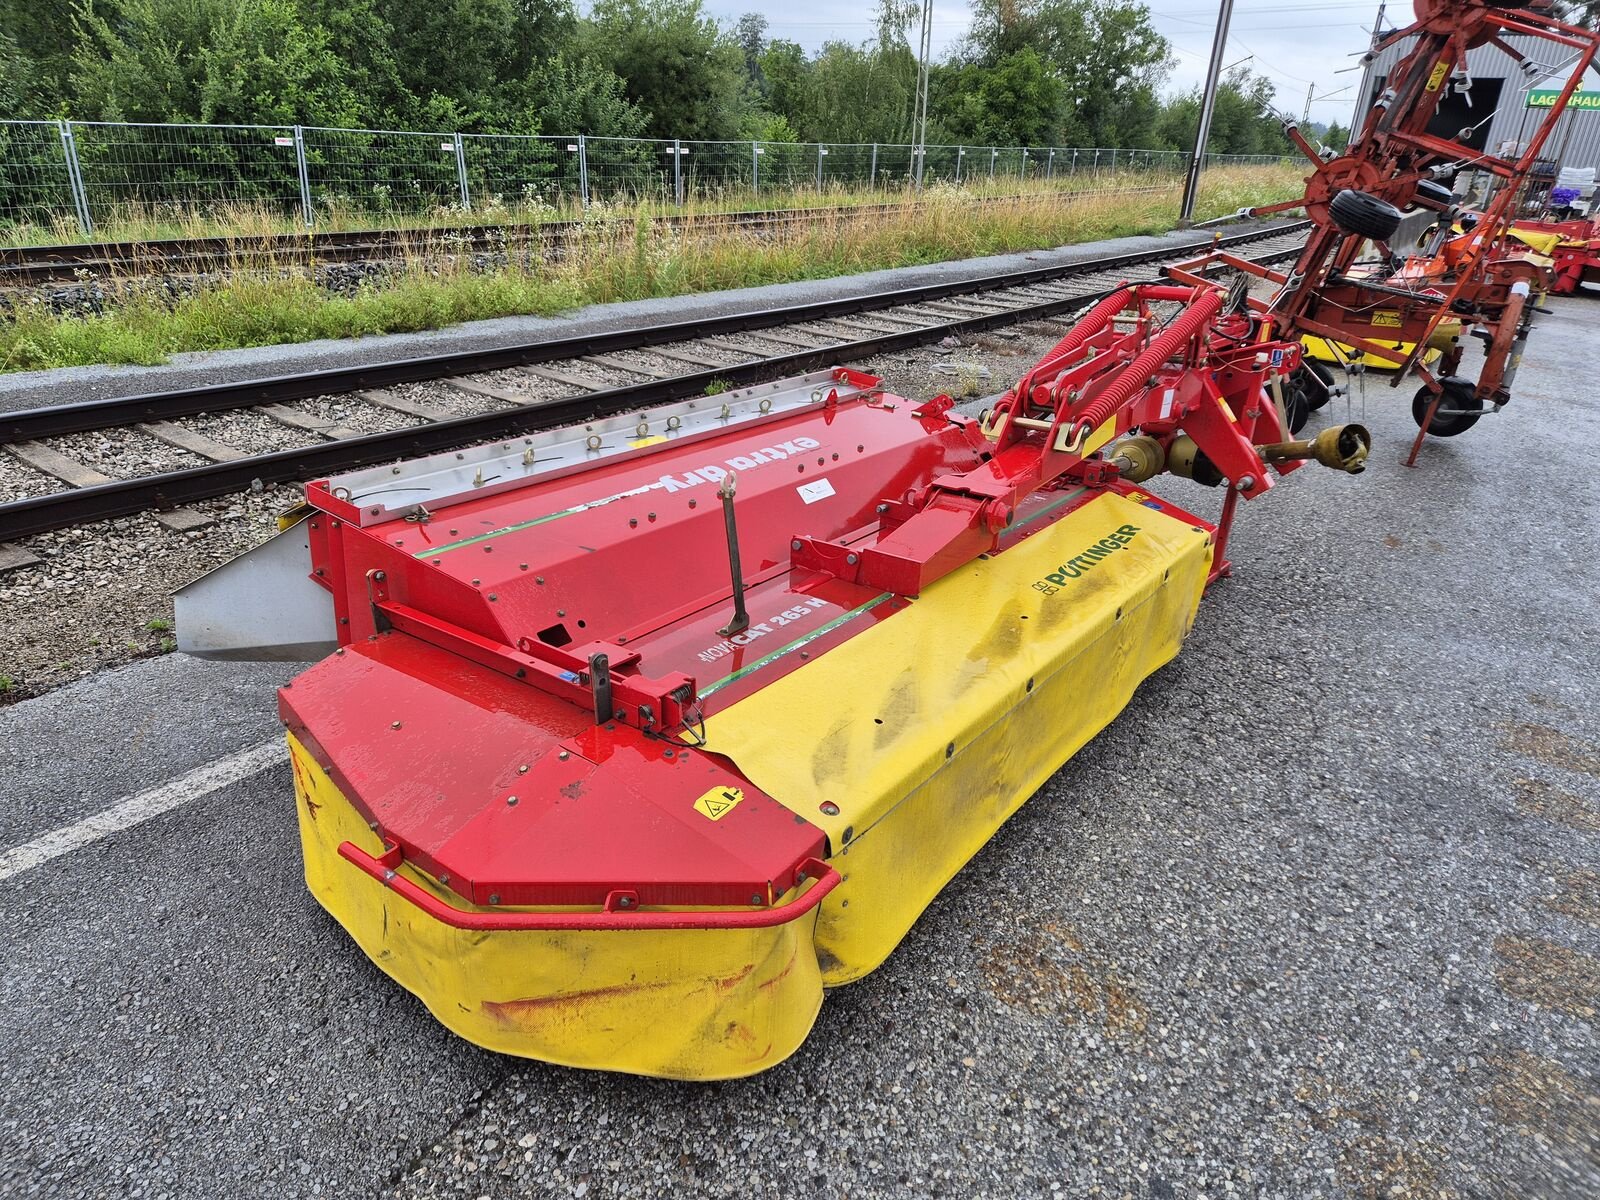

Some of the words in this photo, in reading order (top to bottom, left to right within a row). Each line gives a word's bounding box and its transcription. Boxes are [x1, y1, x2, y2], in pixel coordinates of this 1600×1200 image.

[724, 436, 821, 472] extra
[658, 464, 728, 494] dry
[769, 604, 812, 627] 265
[804, 597, 829, 608] H
